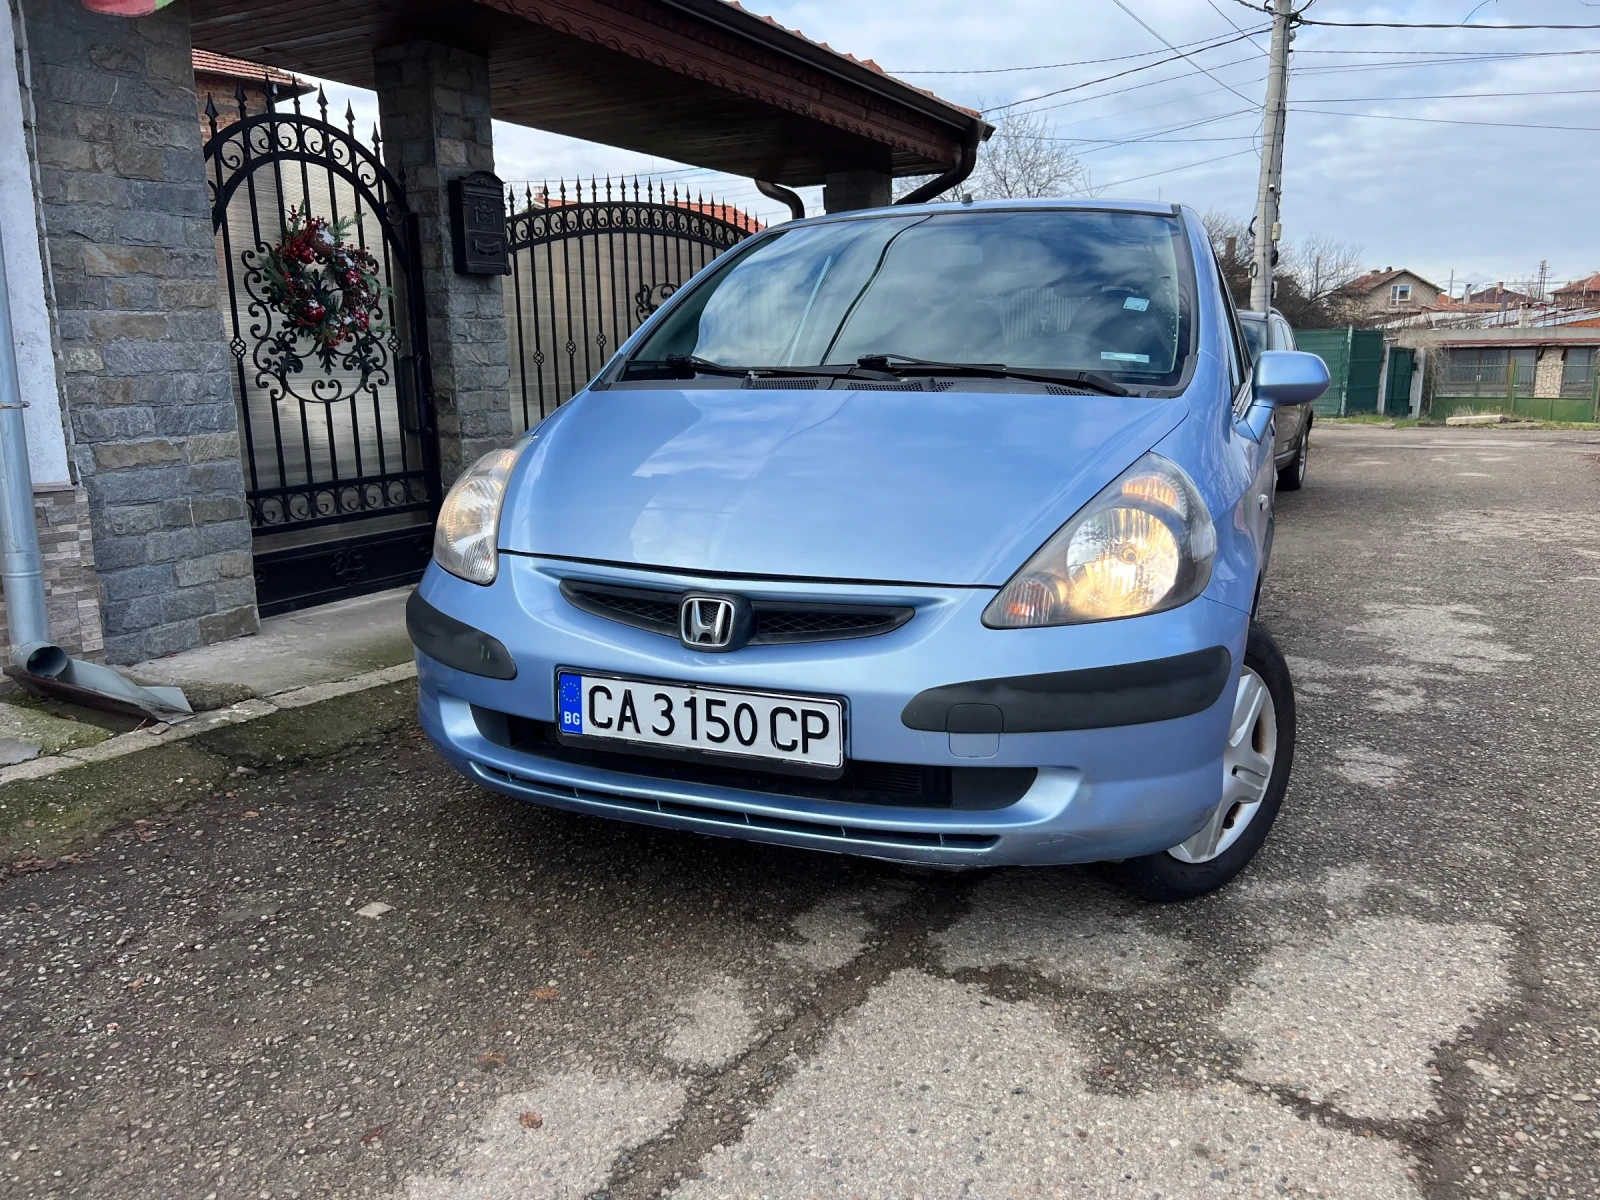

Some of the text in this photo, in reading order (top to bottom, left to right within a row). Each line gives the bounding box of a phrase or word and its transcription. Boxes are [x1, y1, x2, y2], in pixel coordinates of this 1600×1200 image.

[563, 711, 581, 726] BG
[588, 685, 830, 753] CA 3150 CP
